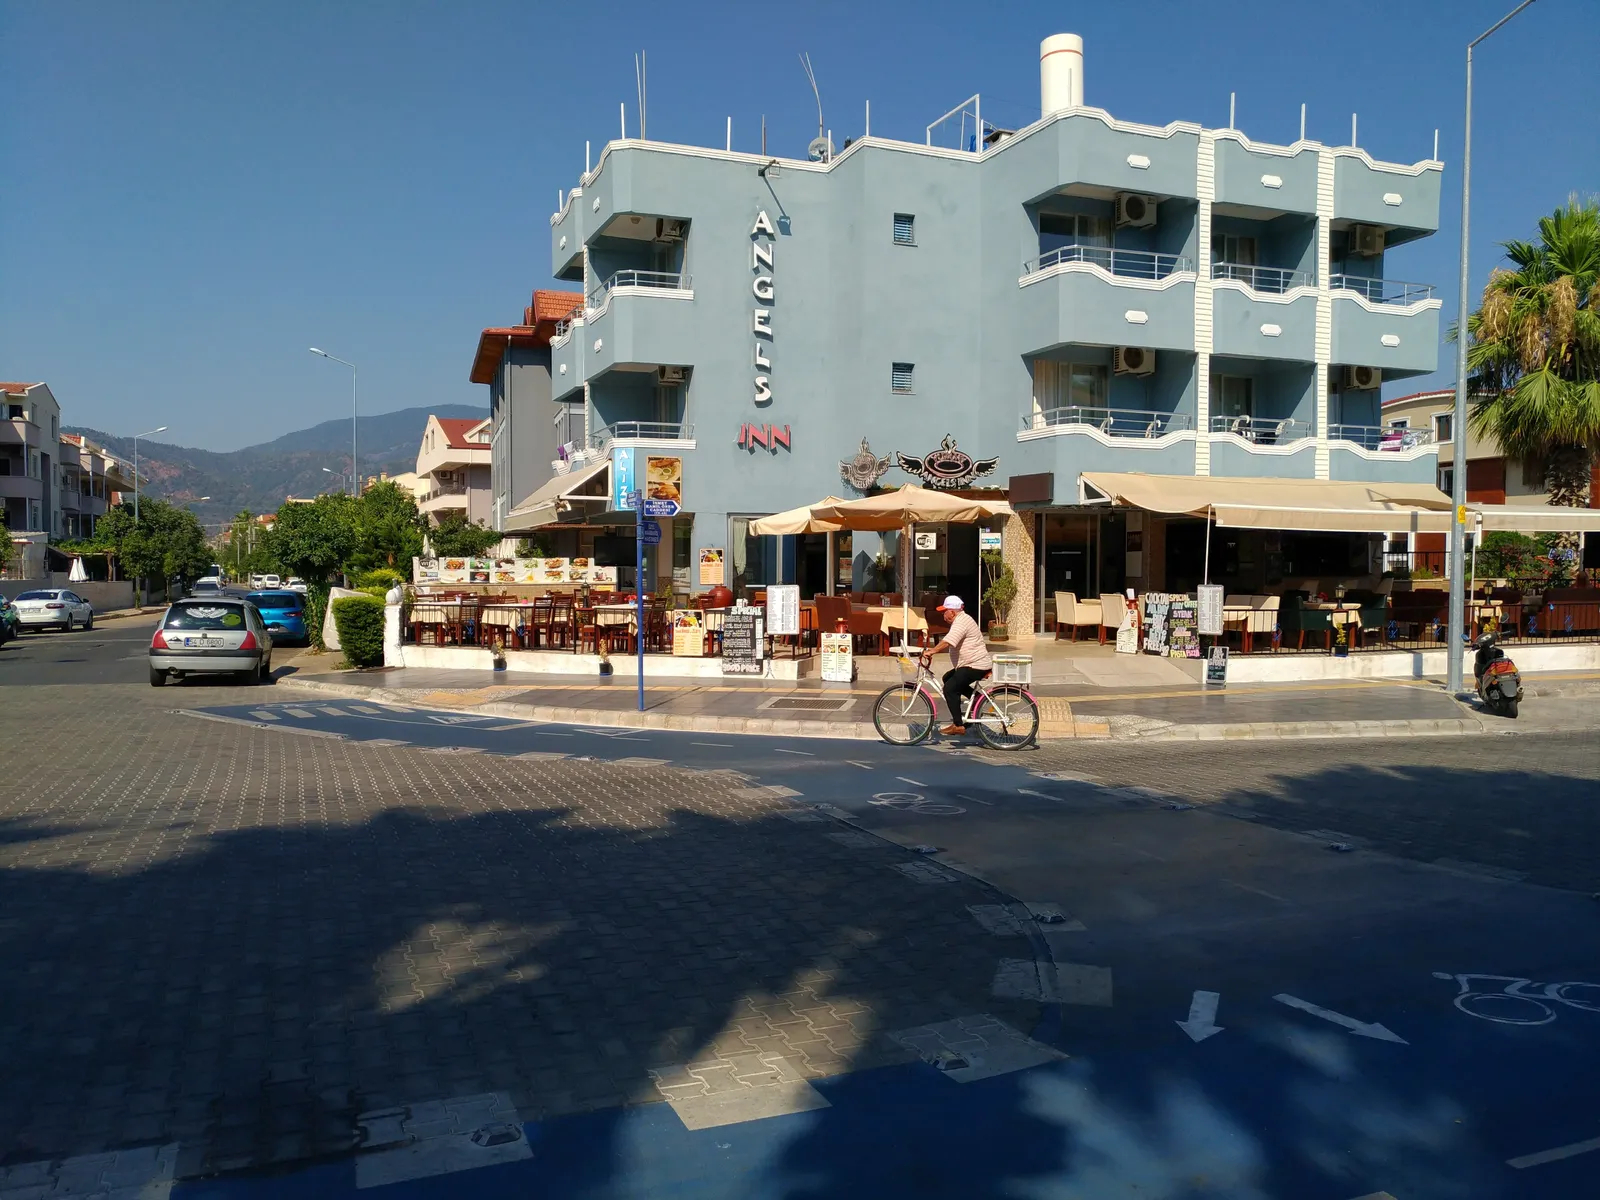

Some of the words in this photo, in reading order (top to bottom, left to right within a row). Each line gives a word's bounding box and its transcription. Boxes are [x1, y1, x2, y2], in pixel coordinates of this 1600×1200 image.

[752, 210, 775, 402] ANGELS
[738, 423, 791, 449] INN
[920, 471, 957, 488] ANGELS
[1173, 610, 1193, 618] STEAK
[1170, 650, 1187, 658] PASTA
